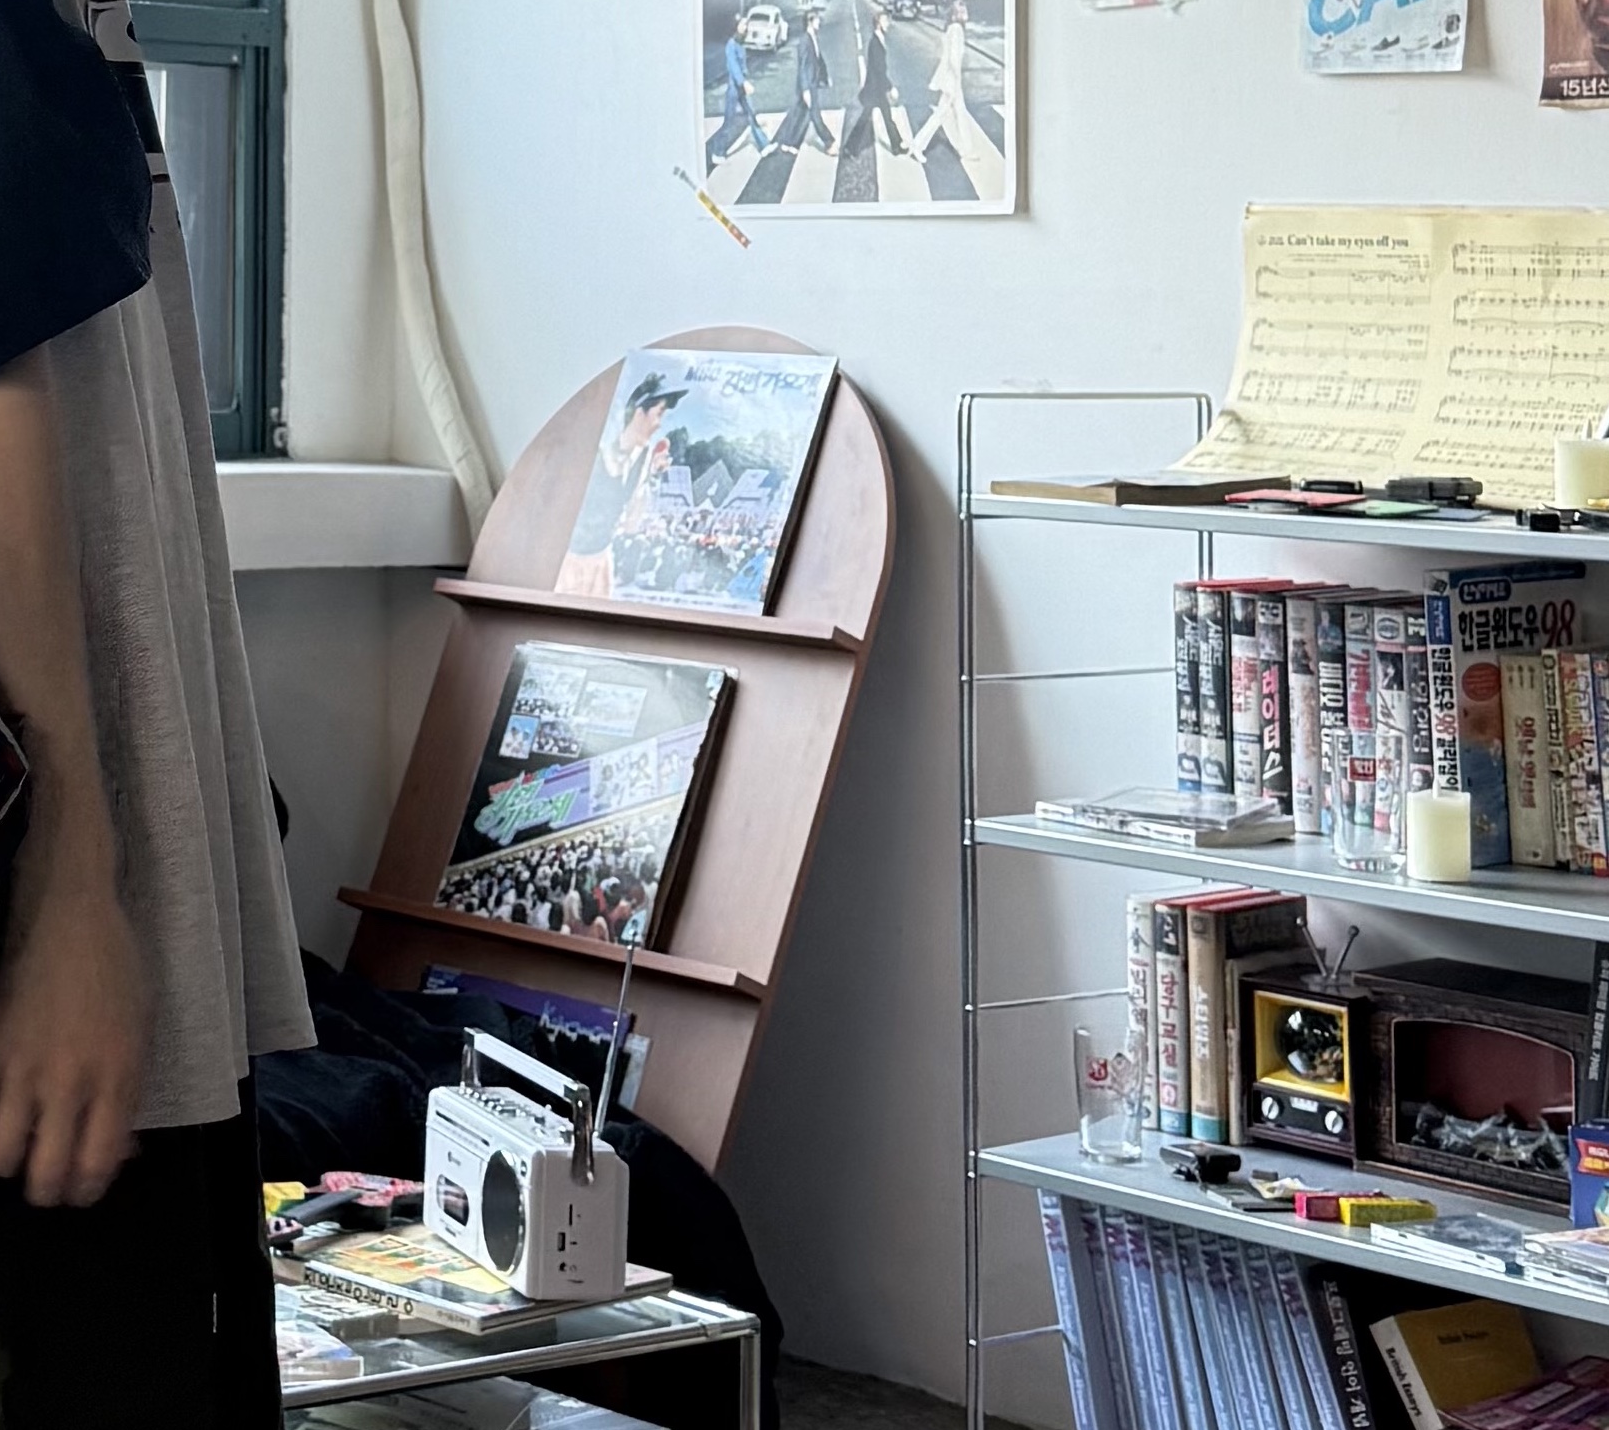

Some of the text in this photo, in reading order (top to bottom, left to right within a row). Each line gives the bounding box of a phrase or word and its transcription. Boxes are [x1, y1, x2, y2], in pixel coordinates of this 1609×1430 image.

[1316, 235, 1335, 246] take
[1338, 237, 1352, 249] my
[1354, 237, 1374, 250] eyes
[1376, 235, 1389, 248] off
[1391, 238, 1409, 250] you
[1457, 598, 1576, 653] 한글윈도우98
[1341, 1360, 1362, 1393] 언어
